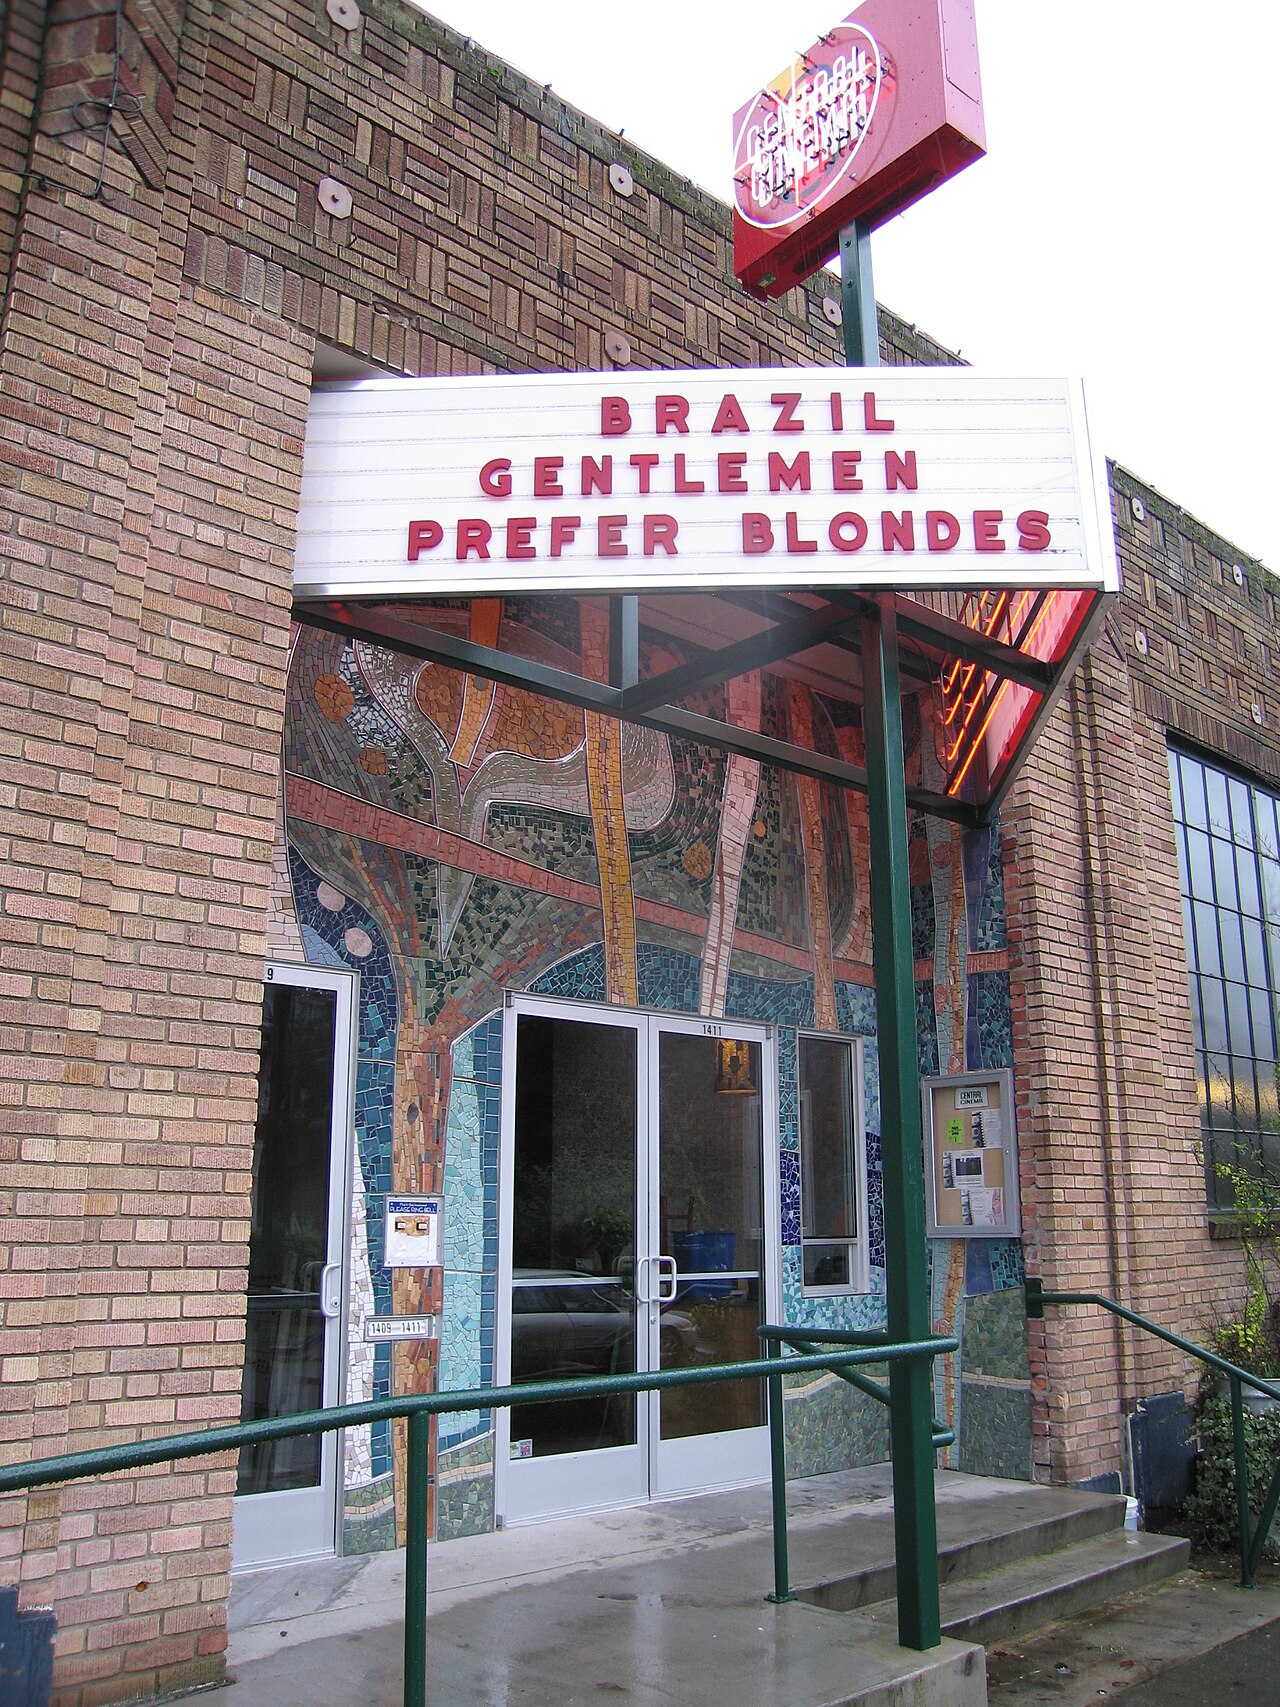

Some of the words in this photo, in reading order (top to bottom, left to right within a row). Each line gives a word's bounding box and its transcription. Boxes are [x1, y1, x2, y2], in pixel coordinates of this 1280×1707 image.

[601, 392, 895, 435] BRAZIL
[479, 451, 918, 497] GENTLEMEN
[407, 513, 678, 562] PREFER
[742, 509, 1052, 555] BLONDES
[703, 1024, 722, 1037] 1411
[960, 1091, 982, 1100] CENTRAL
[372, 1323, 391, 1334] 1409
[402, 1321, 421, 1333] 1411
